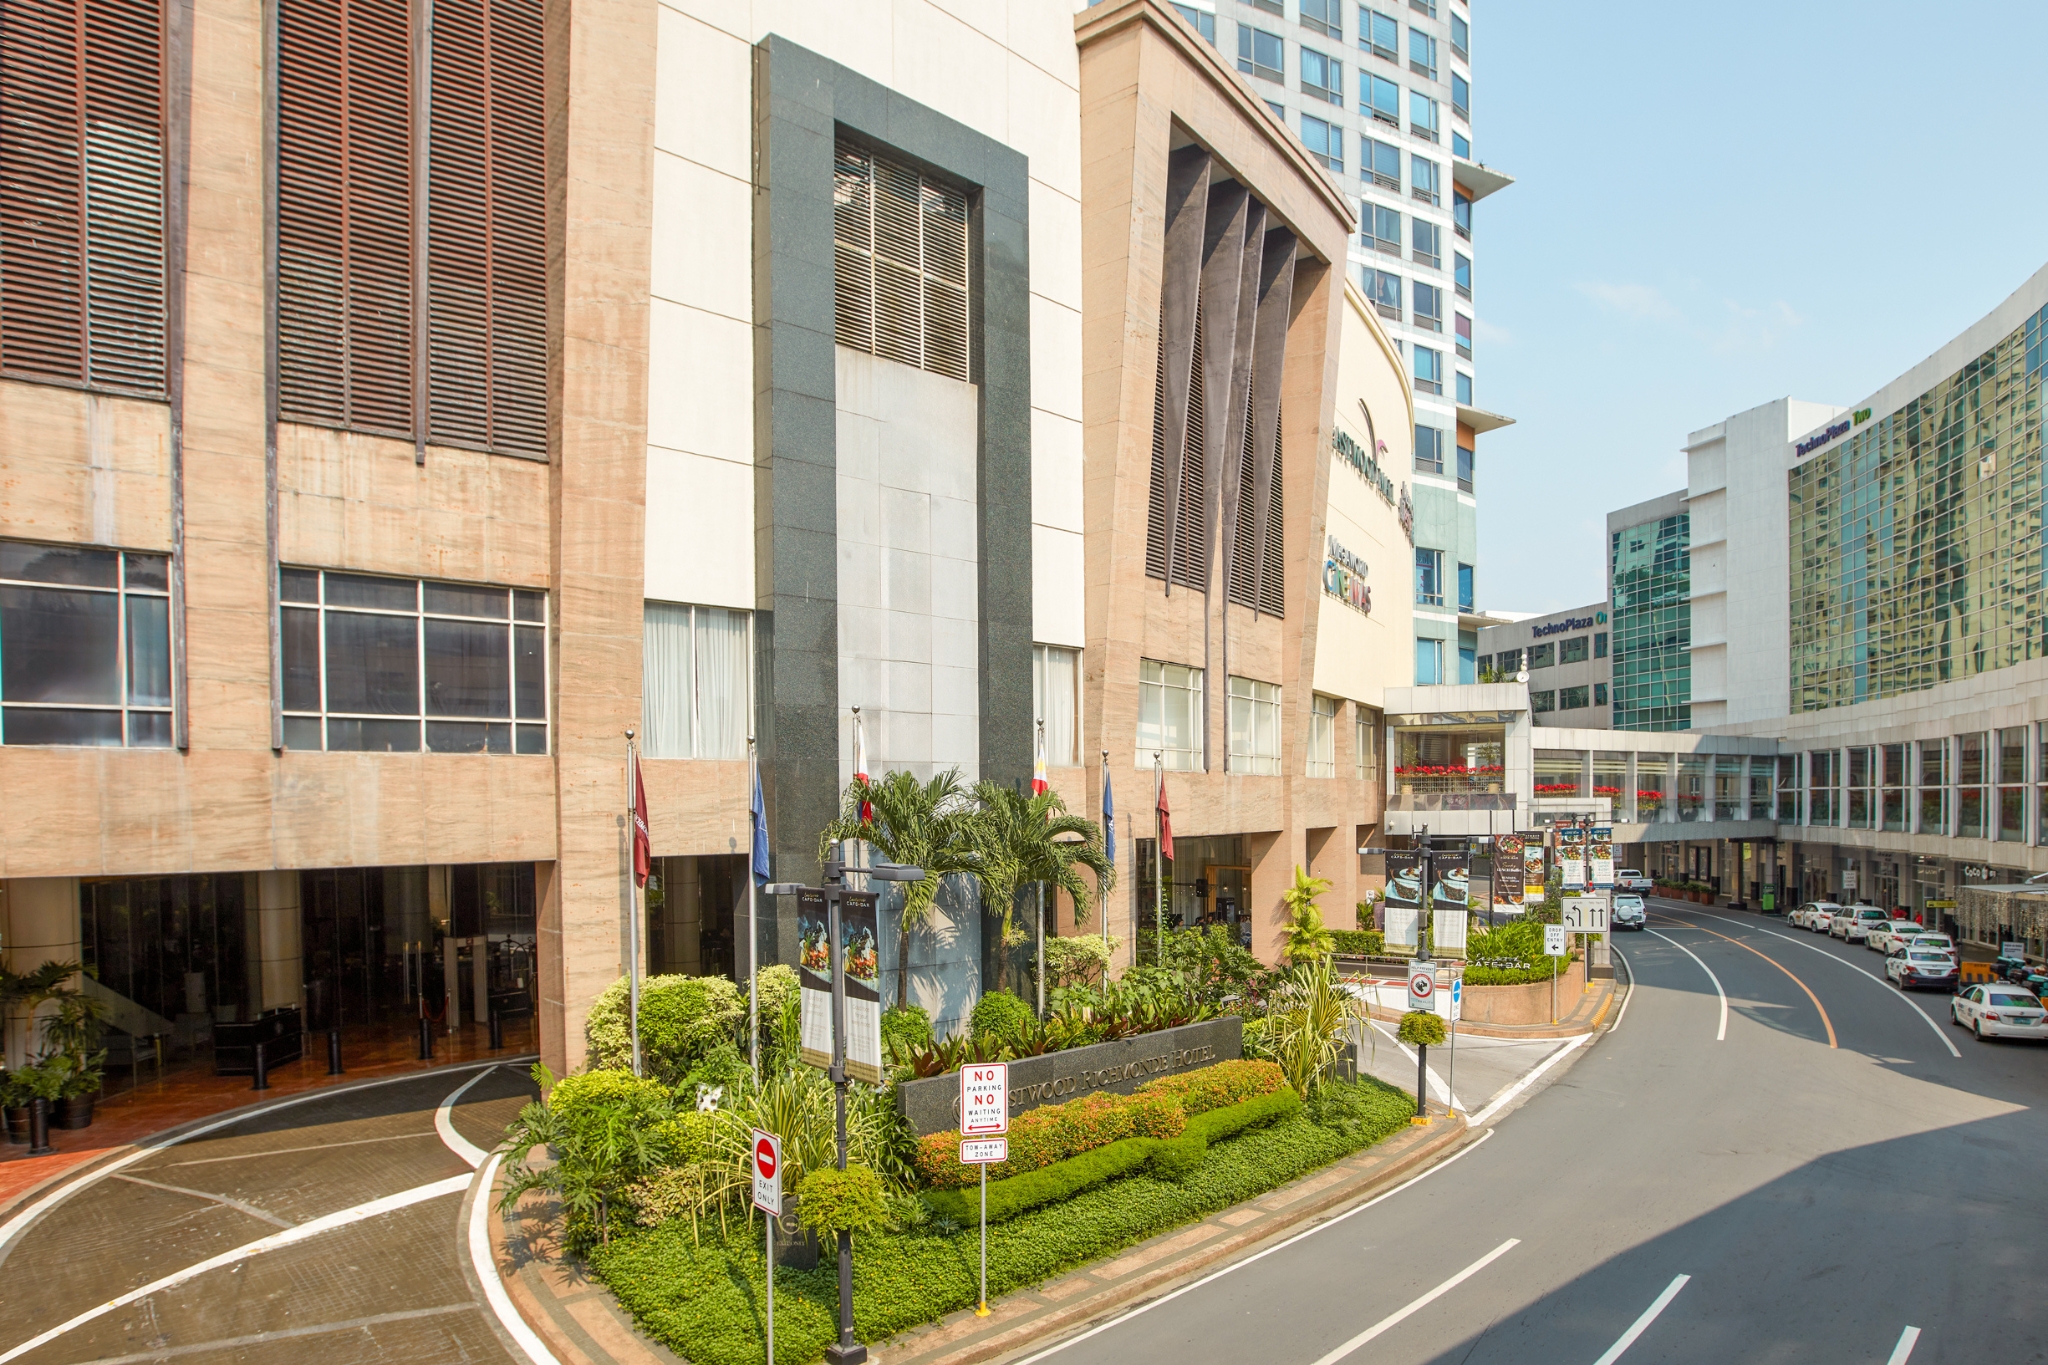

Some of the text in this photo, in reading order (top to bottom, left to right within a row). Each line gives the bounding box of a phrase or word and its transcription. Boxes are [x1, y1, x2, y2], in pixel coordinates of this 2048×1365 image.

[1796, 408, 1871, 457] TechnoPlaza Two
[1328, 535, 1368, 580] MEGAWORLD
[1323, 560, 1371, 613] CINEMAS
[1532, 617, 1593, 638] TechnoPlaza
[1964, 866, 1980, 877] CoCo
[974, 1070, 994, 1081] NO
[1008, 1045, 1215, 1108] STWOOD RICHMONDE HOTEL
[974, 1094, 994, 1105] NO
[968, 1108, 1001, 1116] WAITING
[966, 1143, 1003, 1151] TOW-AWAY
[758, 1180, 773, 1193] EXIT
[757, 1191, 774, 1206] ONLY
